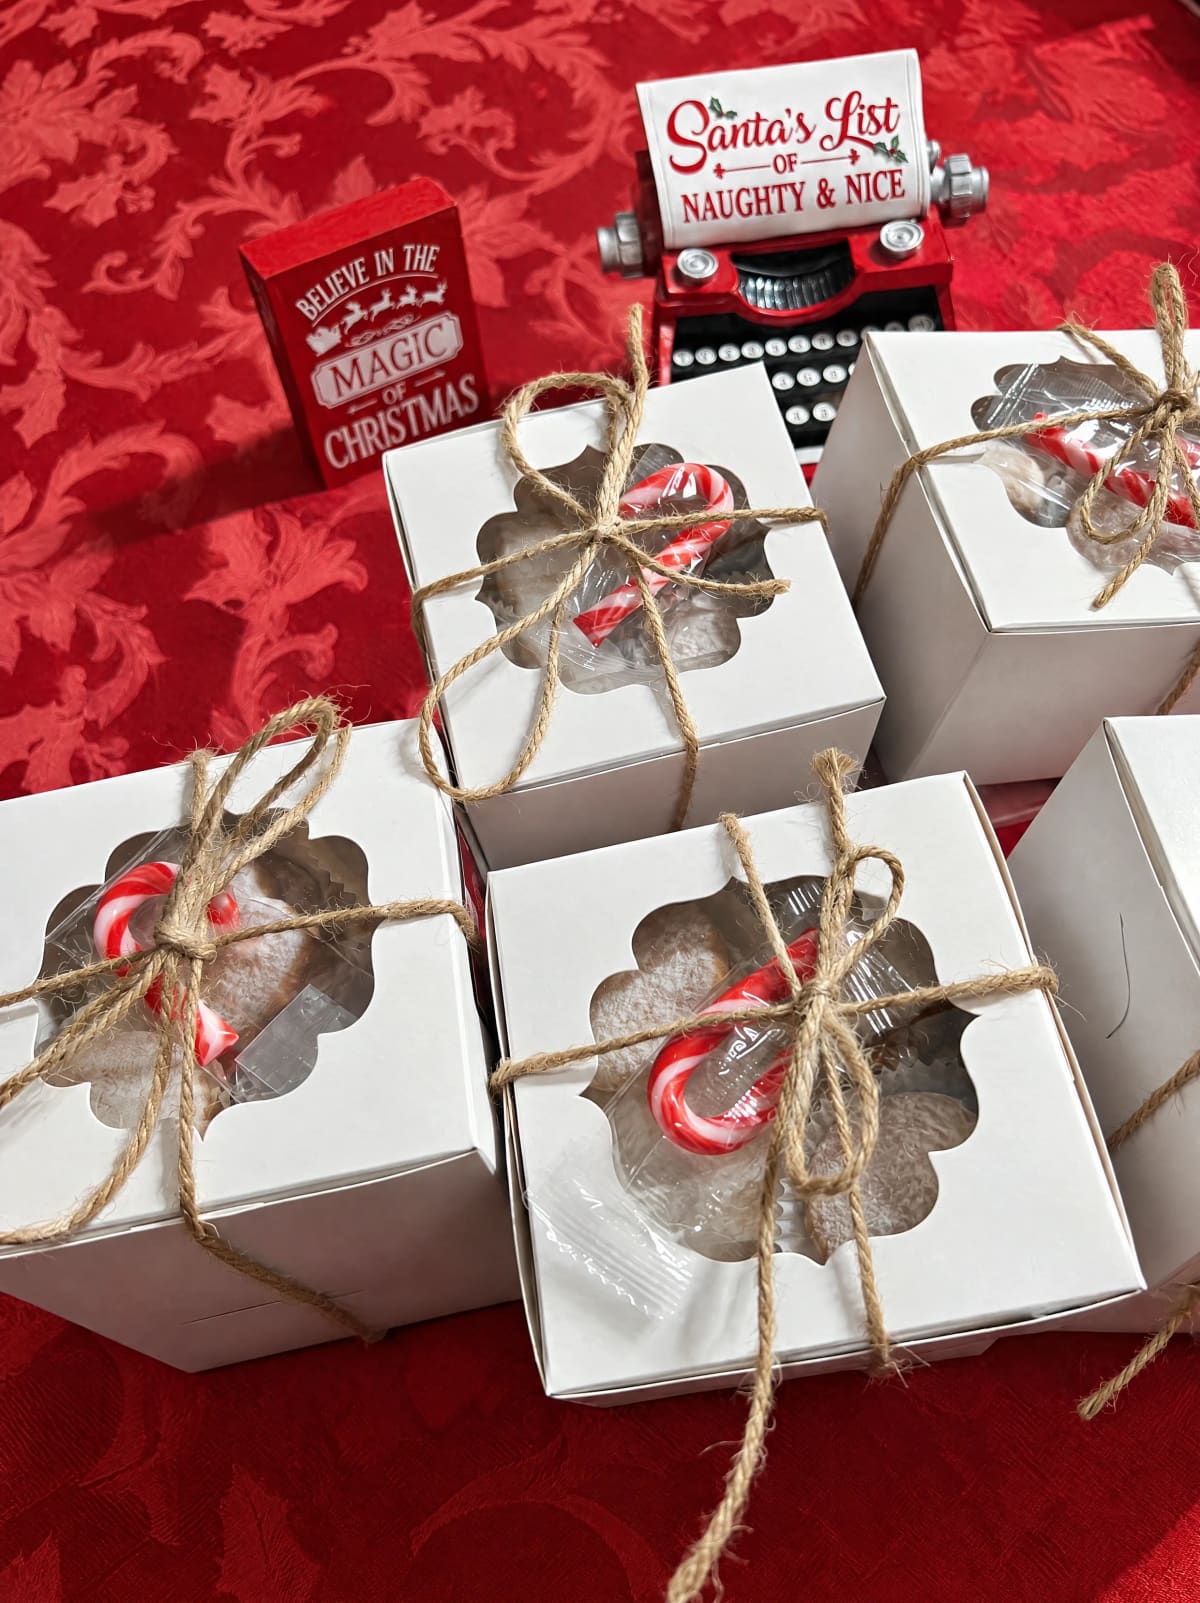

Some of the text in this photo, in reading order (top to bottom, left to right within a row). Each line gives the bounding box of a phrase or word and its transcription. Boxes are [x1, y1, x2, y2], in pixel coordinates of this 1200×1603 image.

[667, 90, 898, 175] Santa's List
[773, 153, 798, 174] OF
[681, 169, 905, 223] NAUGHTY & NICE
[296, 244, 440, 321] BELIEVE IN THE
[331, 322, 448, 398] MAGIC
[382, 382, 406, 404] OF
[324, 374, 479, 469] CHRISTMAS
